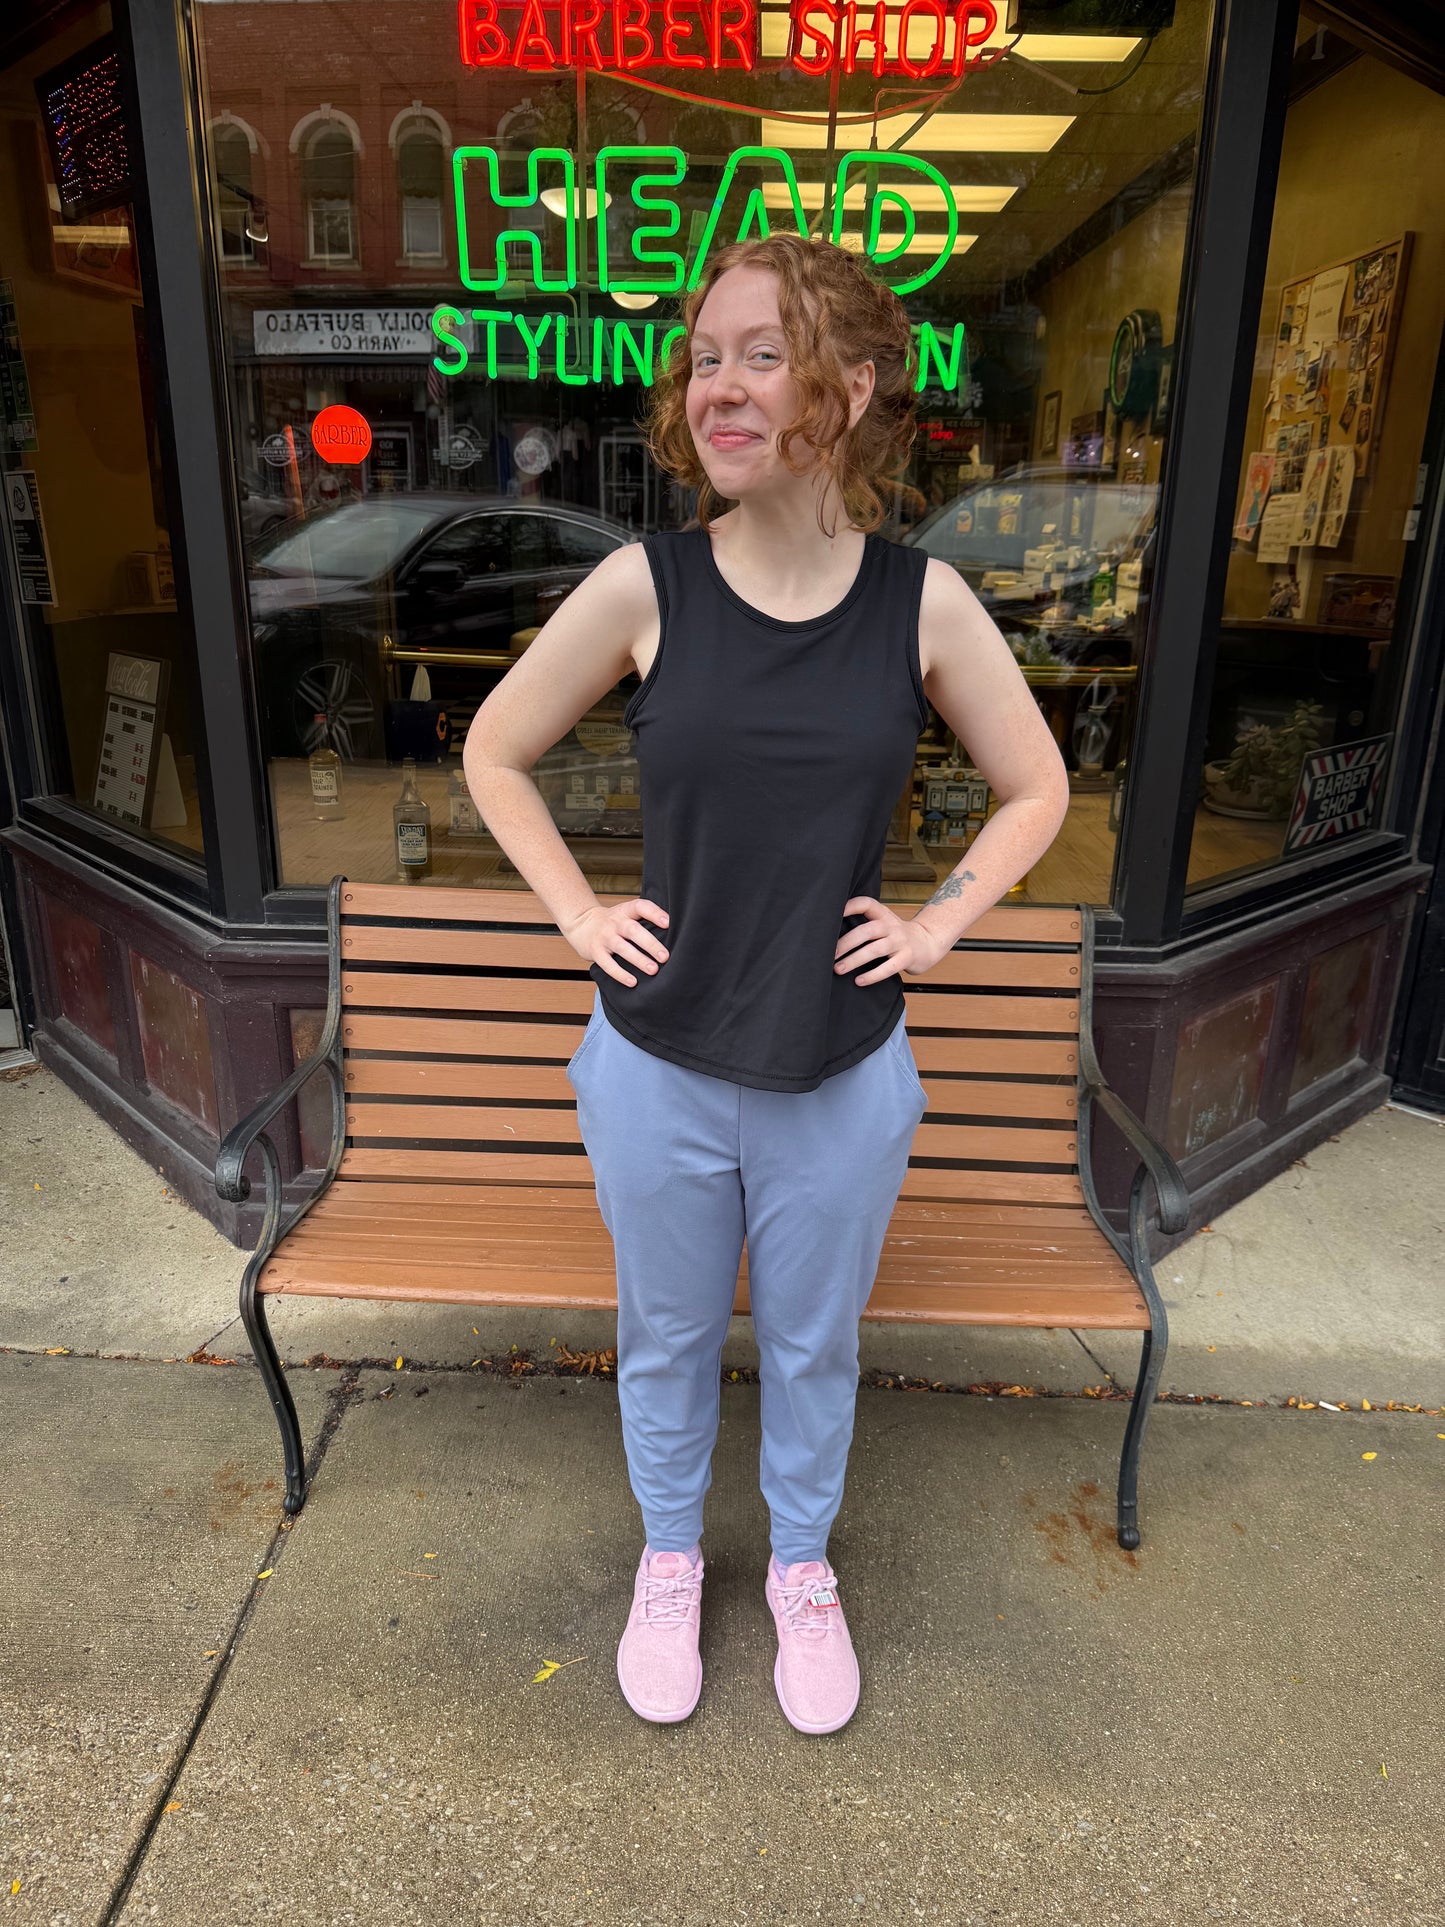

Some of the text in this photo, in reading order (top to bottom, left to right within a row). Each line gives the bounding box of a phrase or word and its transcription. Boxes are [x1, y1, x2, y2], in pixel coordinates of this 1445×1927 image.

[458, 0, 999, 79] BARBER SHOP
[452, 145, 959, 296] HEAD
[314, 424, 368, 447] BARBER
[1313, 766, 1371, 801] BARBER
[1318, 791, 1357, 820] SHOP
